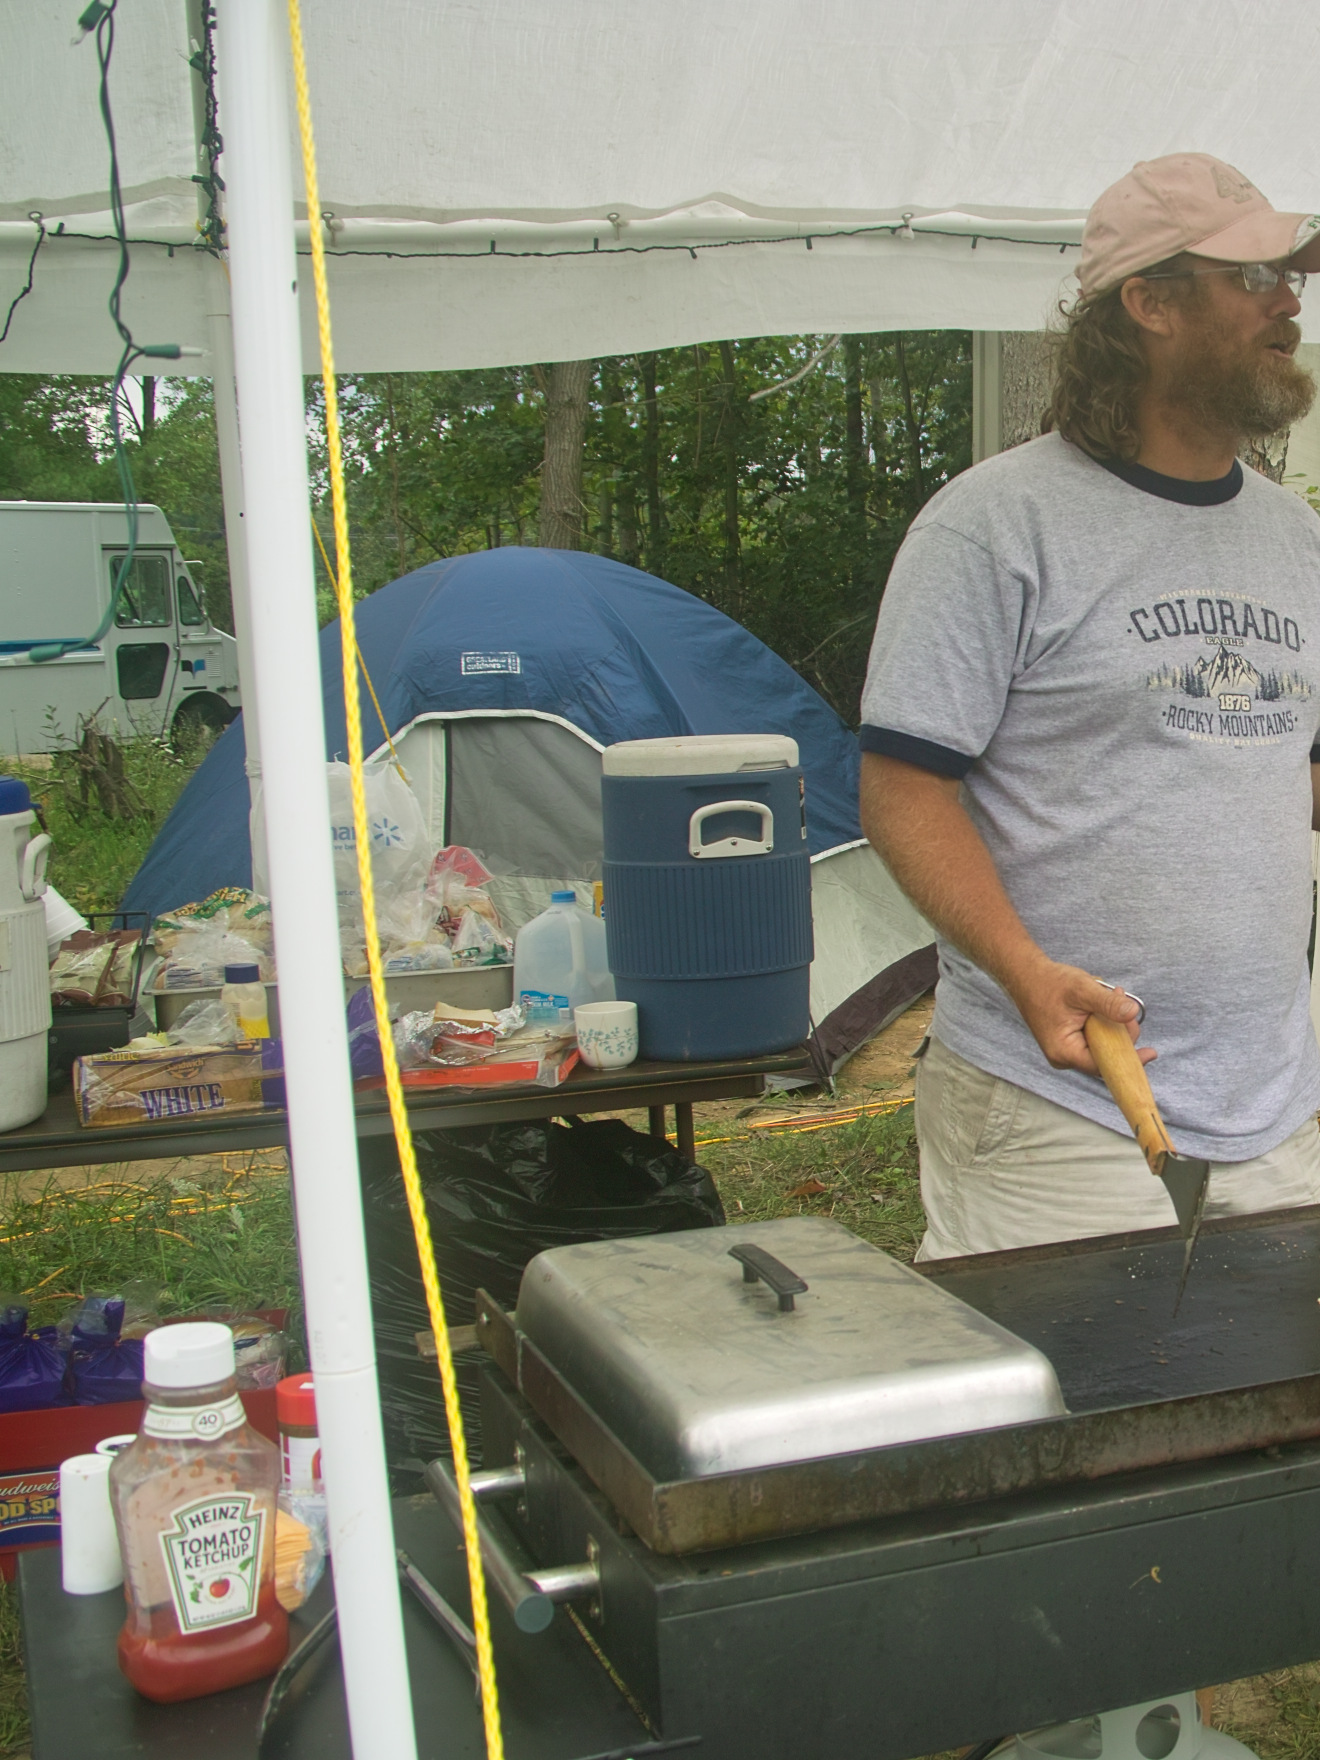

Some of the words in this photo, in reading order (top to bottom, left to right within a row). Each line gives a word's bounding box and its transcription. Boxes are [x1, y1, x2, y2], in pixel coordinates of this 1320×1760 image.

[1130, 598, 1300, 652] COLORADO
[1205, 636, 1244, 647] EAGLE
[1218, 693, 1251, 712] 1876
[1166, 704, 1214, 735] ROCKY
[1218, 710, 1294, 738] MOUNTAINS
[139, 1083, 225, 1120] WHITE
[198, 1413, 218, 1425] 40
[0, 1478, 61, 1497] udweis
[0, 1501, 26, 1521] OD
[30, 1497, 61, 1515] SP
[189, 1505, 240, 1528] HEINZ
[178, 1526, 252, 1556] TOMATO
[183, 1543, 249, 1570] KETCHUP
